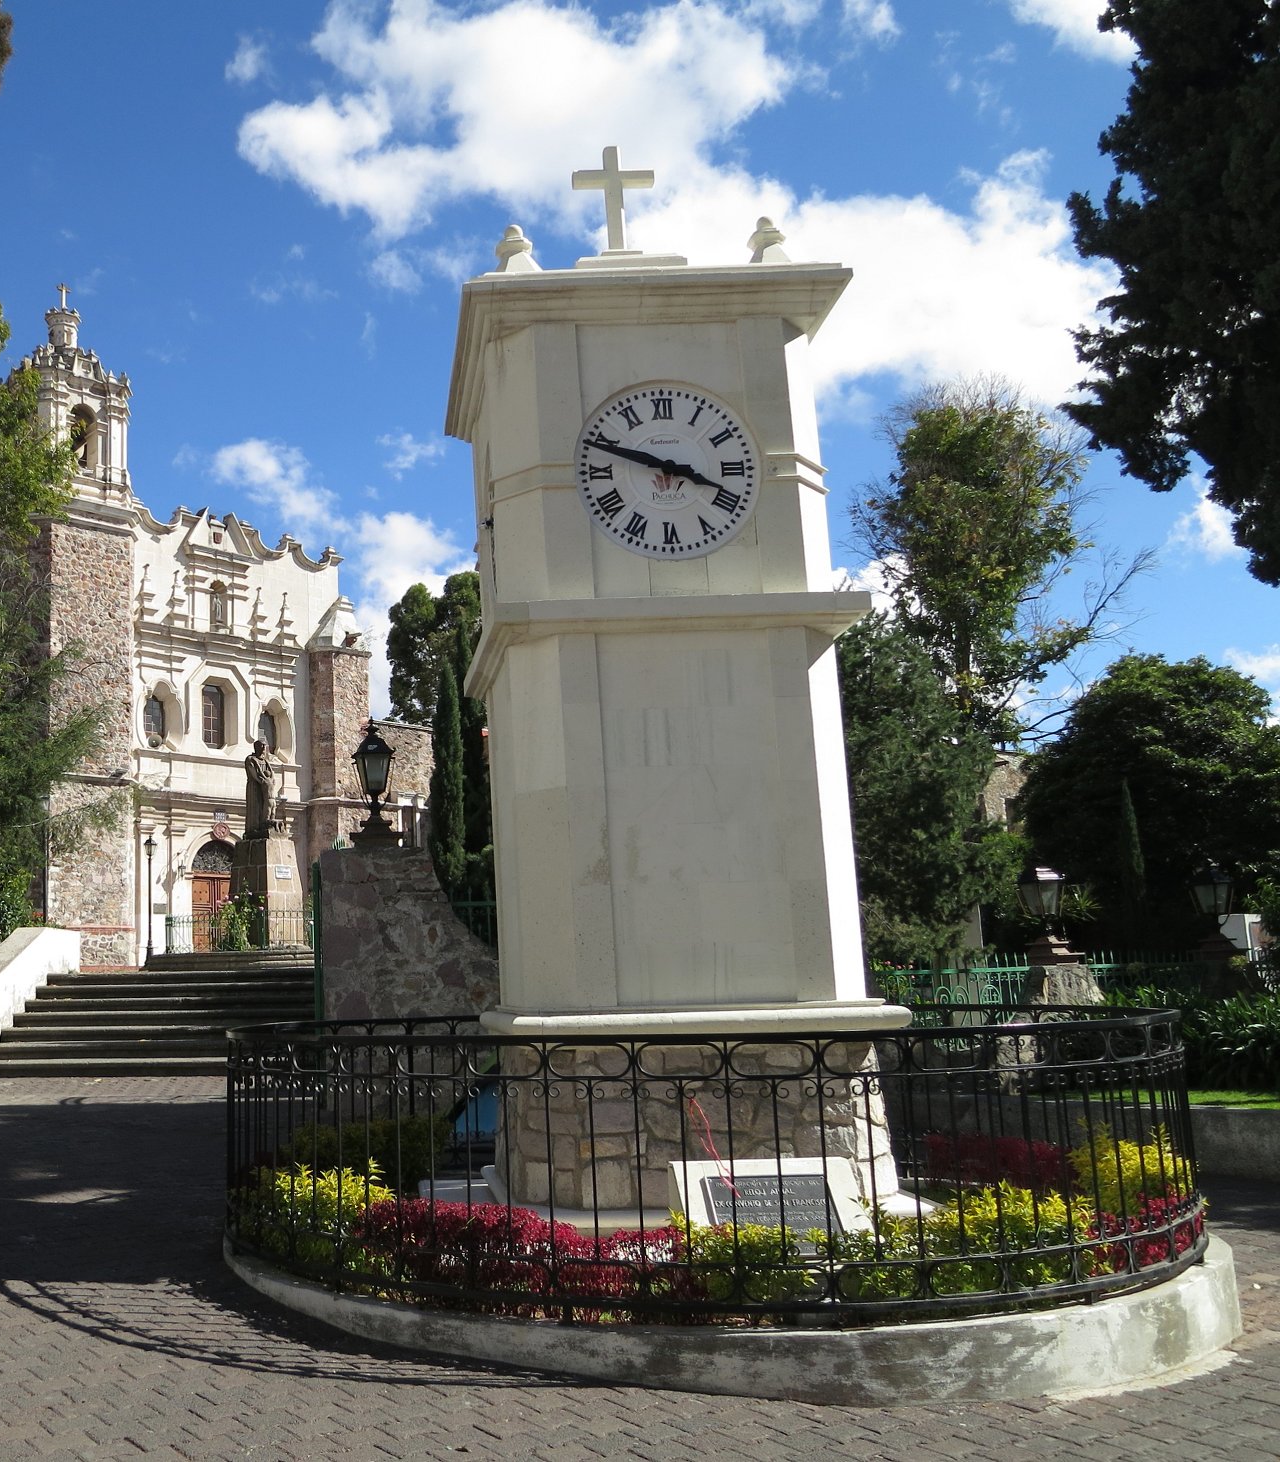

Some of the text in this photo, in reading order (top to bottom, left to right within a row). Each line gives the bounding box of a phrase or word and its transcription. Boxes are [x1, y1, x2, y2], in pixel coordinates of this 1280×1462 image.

[618, 405, 643, 431] XI
[651, 398, 674, 420] XII
[721, 461, 744, 477] III
[623, 512, 648, 540] VII
[663, 522, 680, 544] VI
